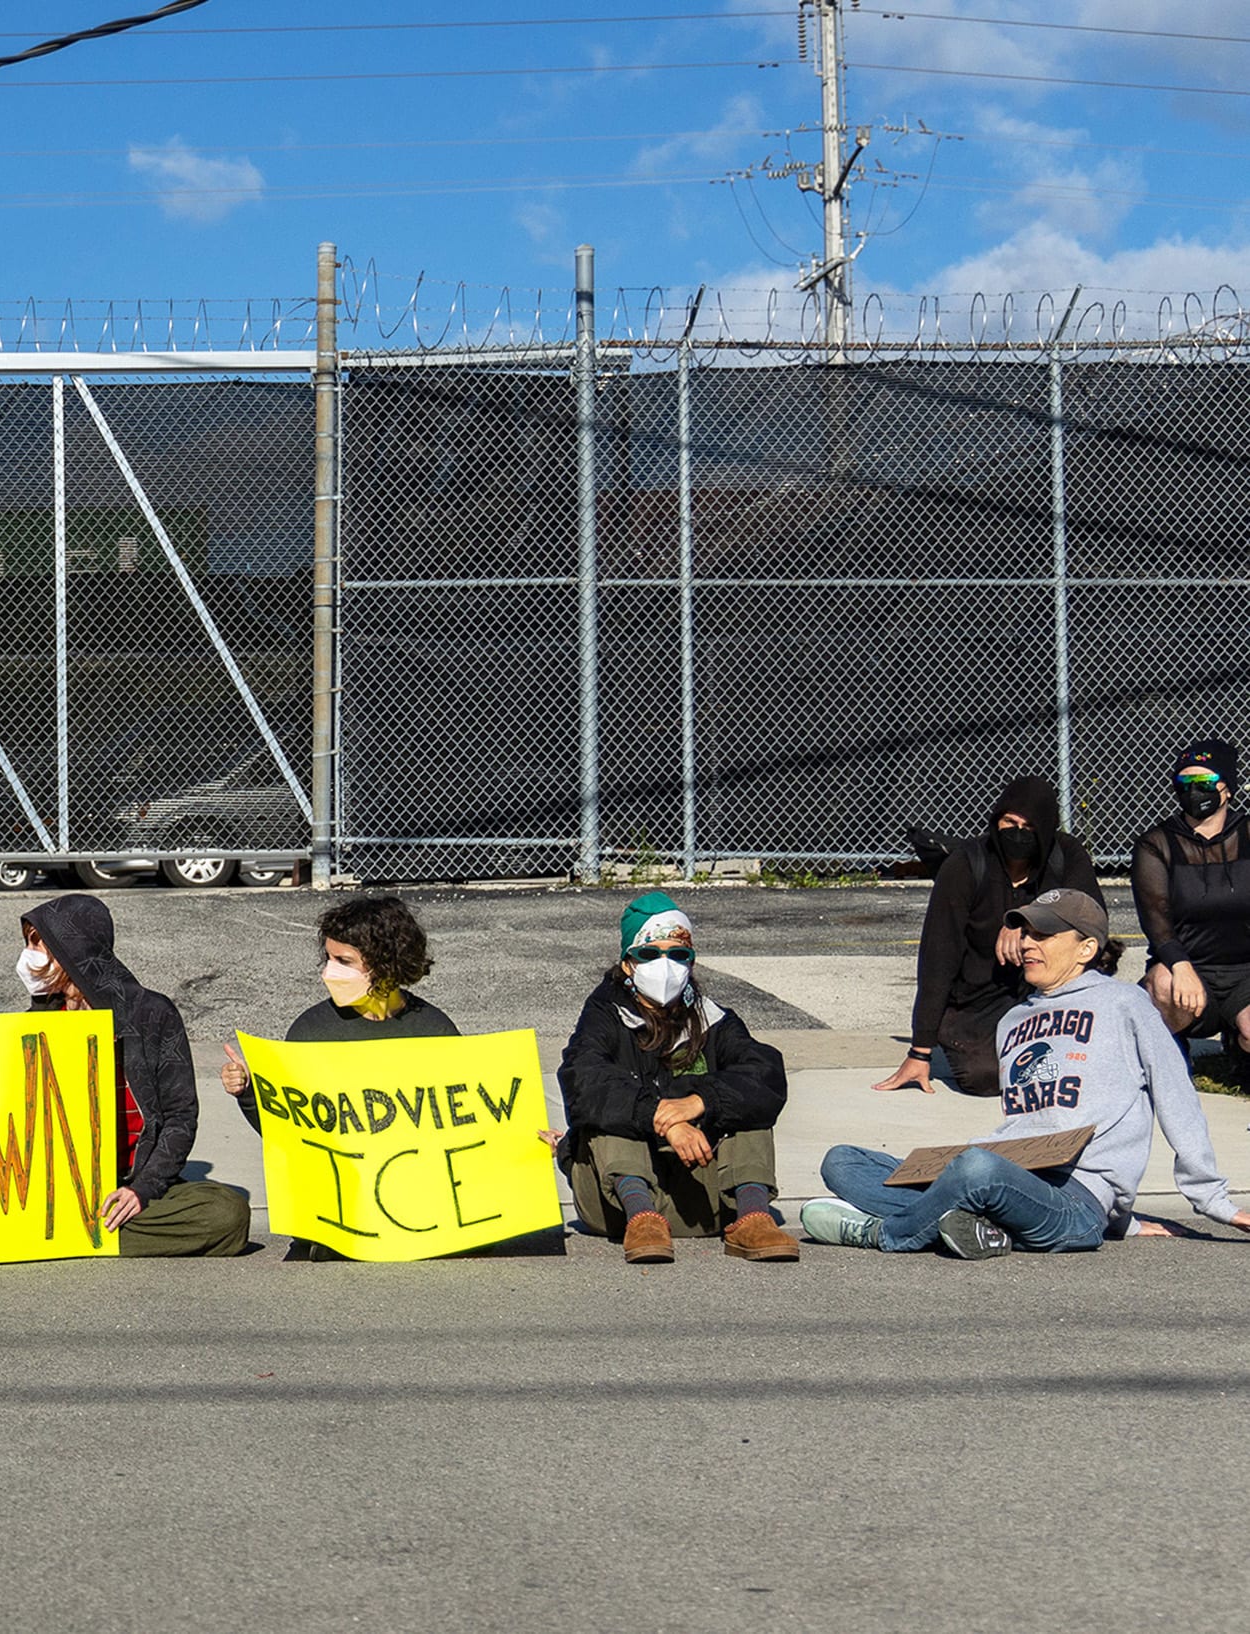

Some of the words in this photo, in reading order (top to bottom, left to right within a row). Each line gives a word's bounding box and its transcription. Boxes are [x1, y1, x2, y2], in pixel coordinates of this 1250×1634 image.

[1000, 1009, 1094, 1059] CHICAGO
[253, 1077, 522, 1135] BROADVIEW
[1004, 1076, 1081, 1116] EARS
[302, 1140, 502, 1238] ICE
